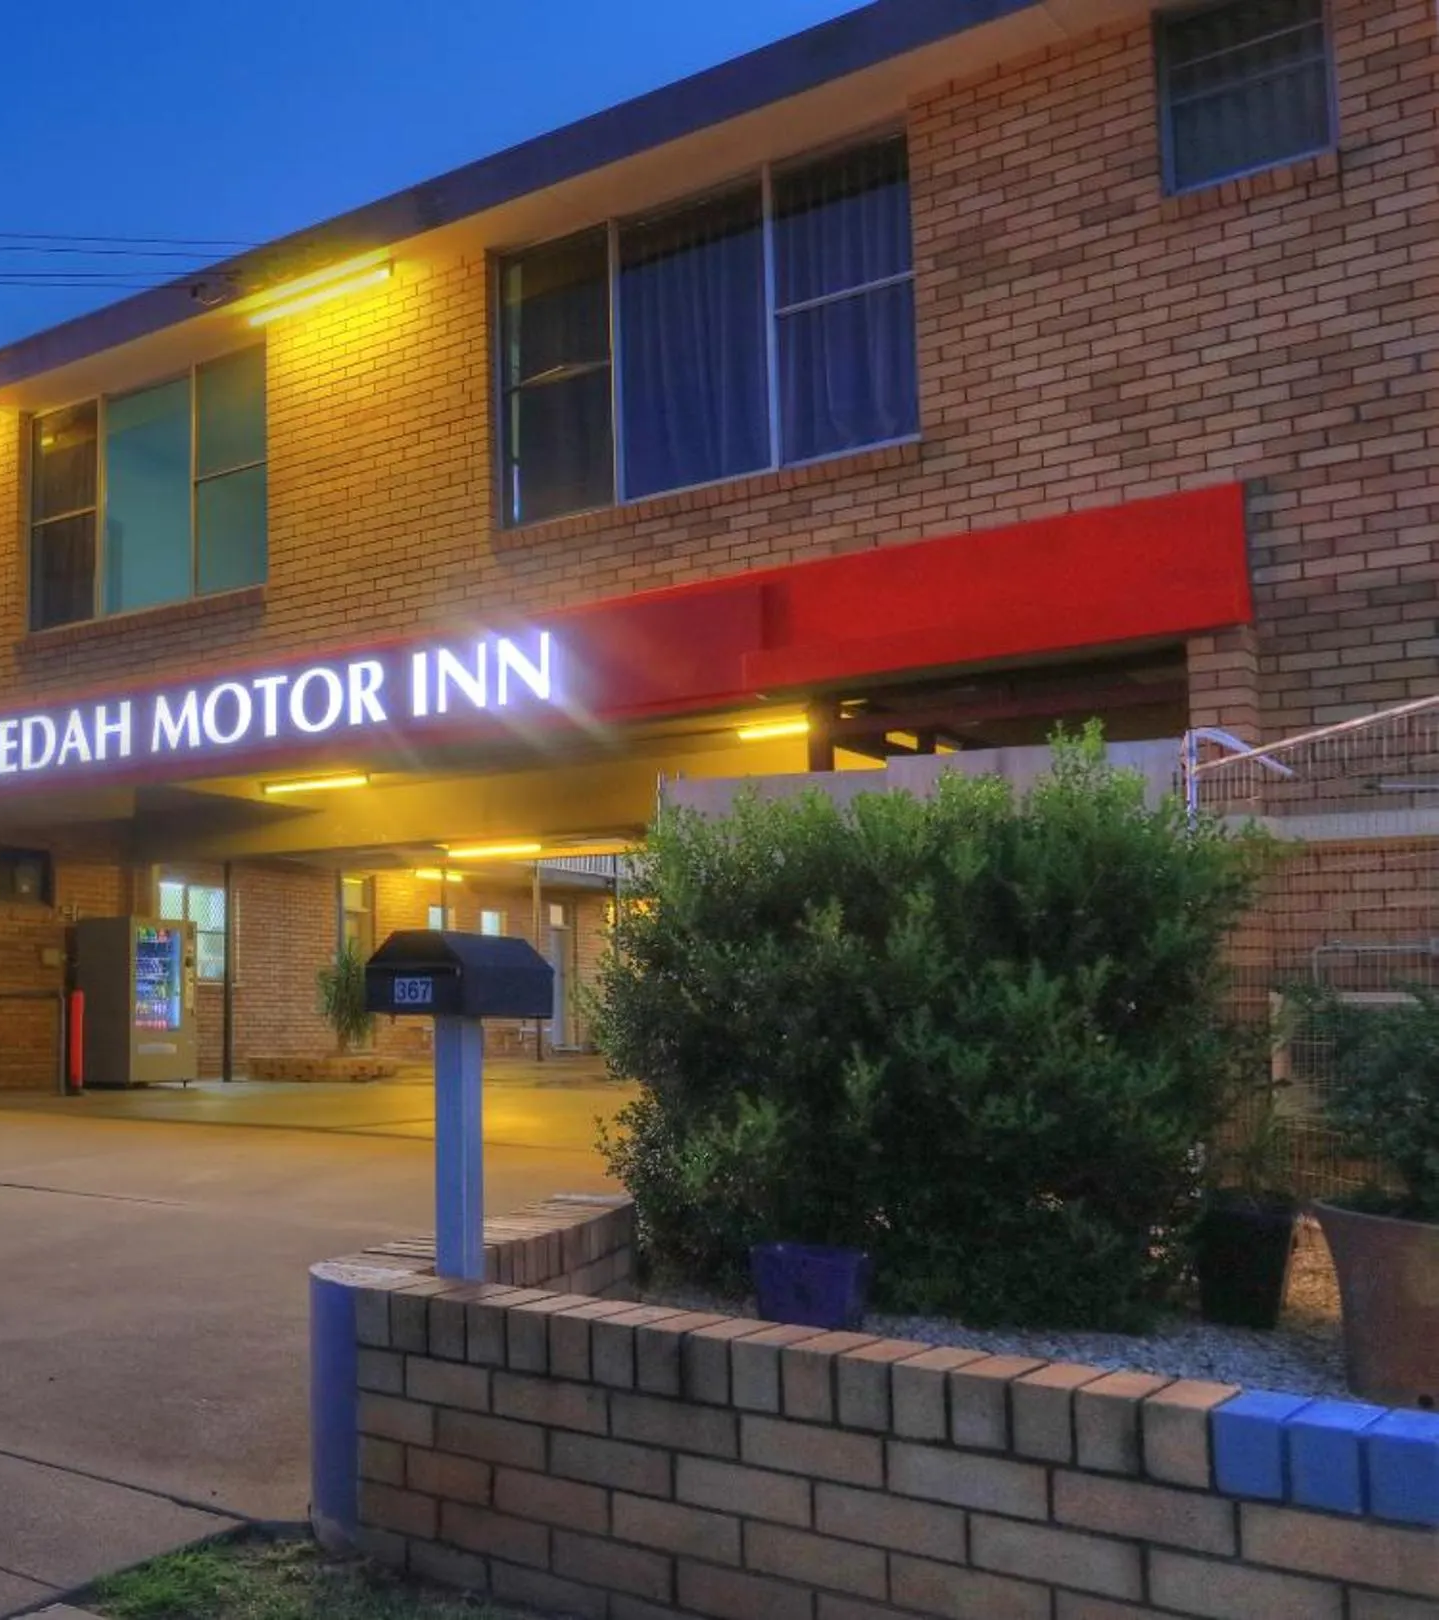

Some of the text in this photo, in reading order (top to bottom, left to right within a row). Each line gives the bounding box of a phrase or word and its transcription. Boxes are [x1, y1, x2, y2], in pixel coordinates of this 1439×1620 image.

[150, 660, 388, 753] MOTOR
[411, 631, 551, 717] INN
[396, 980, 431, 1001] 367
